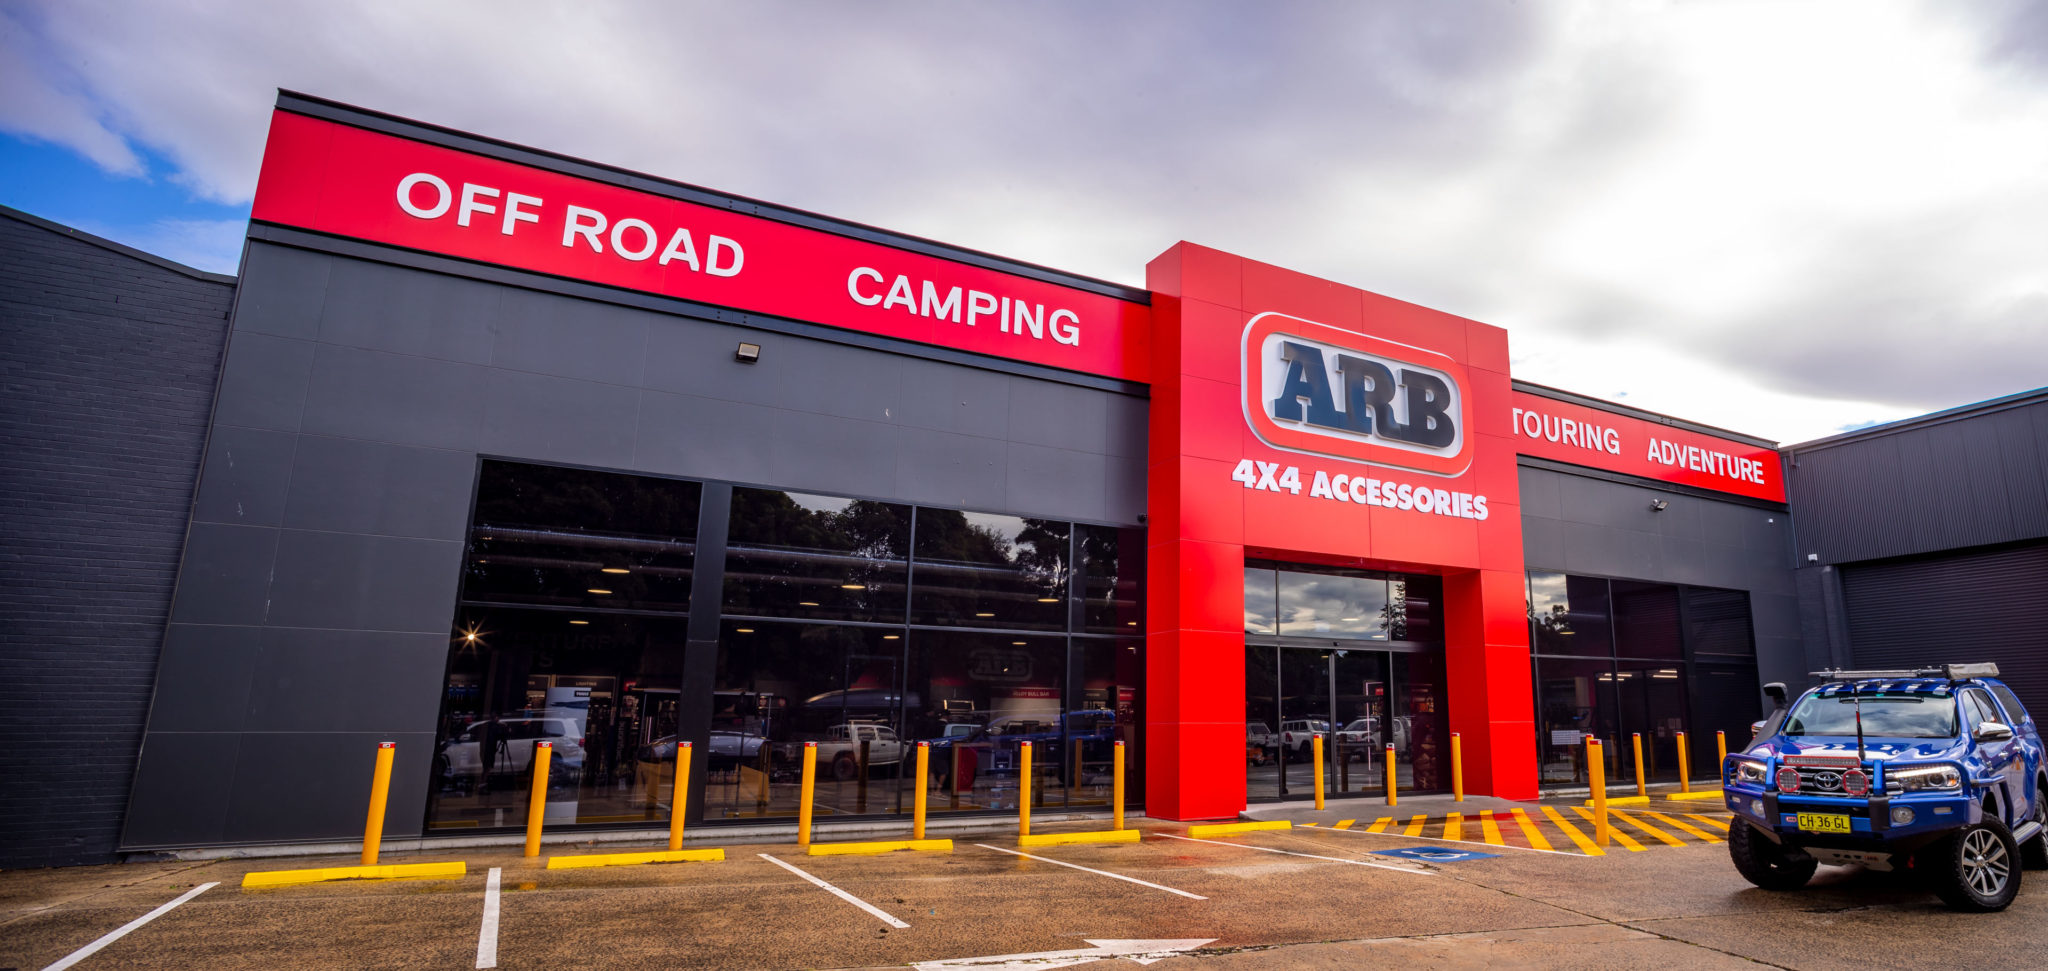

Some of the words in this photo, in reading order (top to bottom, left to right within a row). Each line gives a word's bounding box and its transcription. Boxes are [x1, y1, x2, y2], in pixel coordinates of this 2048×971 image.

[396, 173, 543, 236] OFF
[562, 204, 745, 278] ROAD
[847, 266, 1080, 347] CAMPING
[1271, 340, 1456, 449] ARB
[1512, 407, 1620, 455] TOURING
[1647, 437, 1765, 485] ADVENTURE
[1232, 459, 1302, 495] 4X4
[1310, 470, 1489, 521] ACCESSORIES
